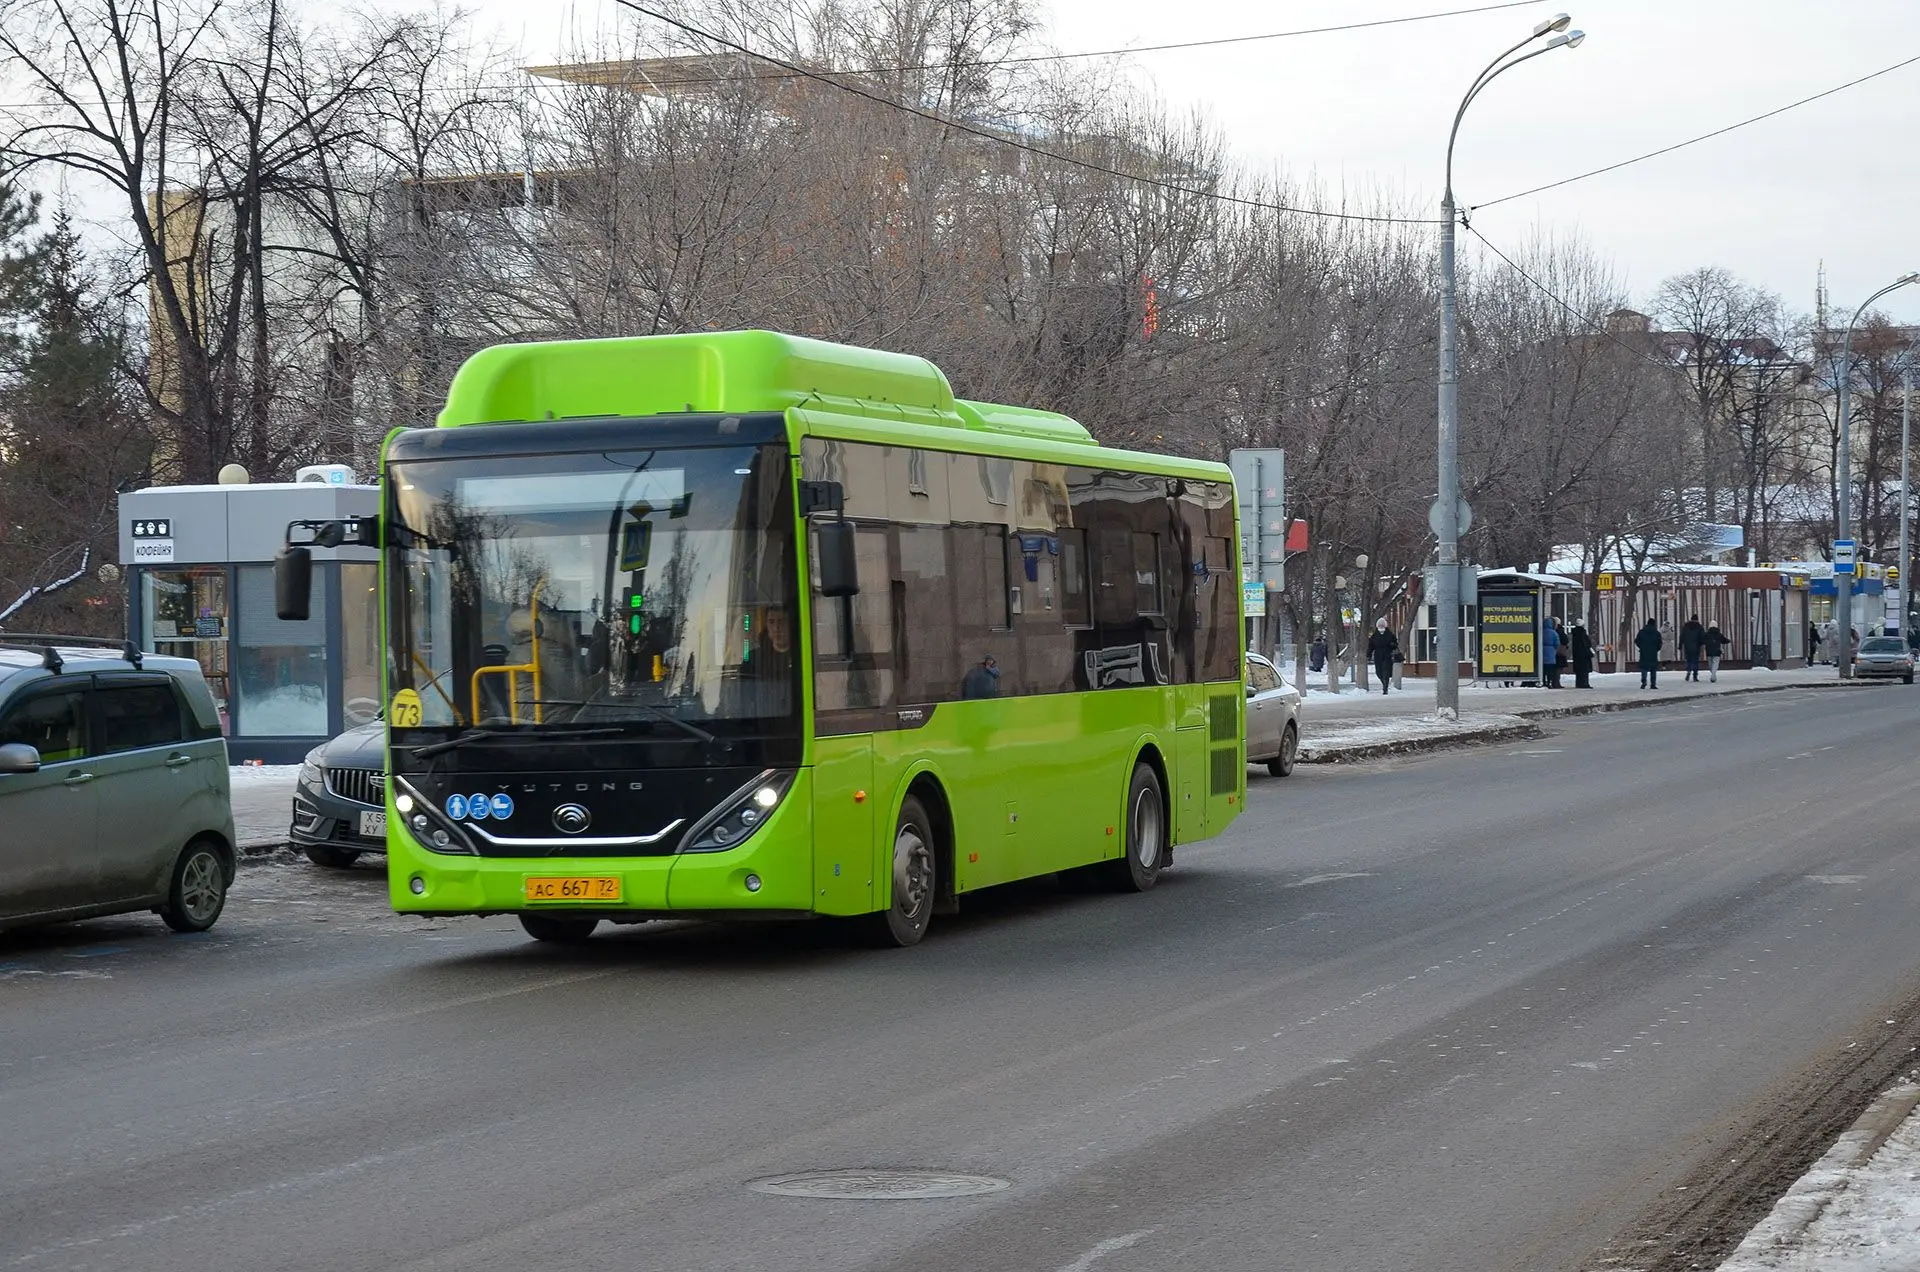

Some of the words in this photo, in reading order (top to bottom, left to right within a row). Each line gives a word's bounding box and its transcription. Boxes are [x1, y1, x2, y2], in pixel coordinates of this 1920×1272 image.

[136, 544, 172, 556] КОФЕЙНЯ
[1703, 574, 1728, 586] КОФЕ
[1483, 615, 1532, 623] РЕКЛАМЫ
[1484, 643, 1531, 653] 490-860
[397, 703, 419, 726] 73
[498, 782, 643, 793] YUTONG
[562, 880, 589, 896] 667
[599, 880, 614, 892] 72
